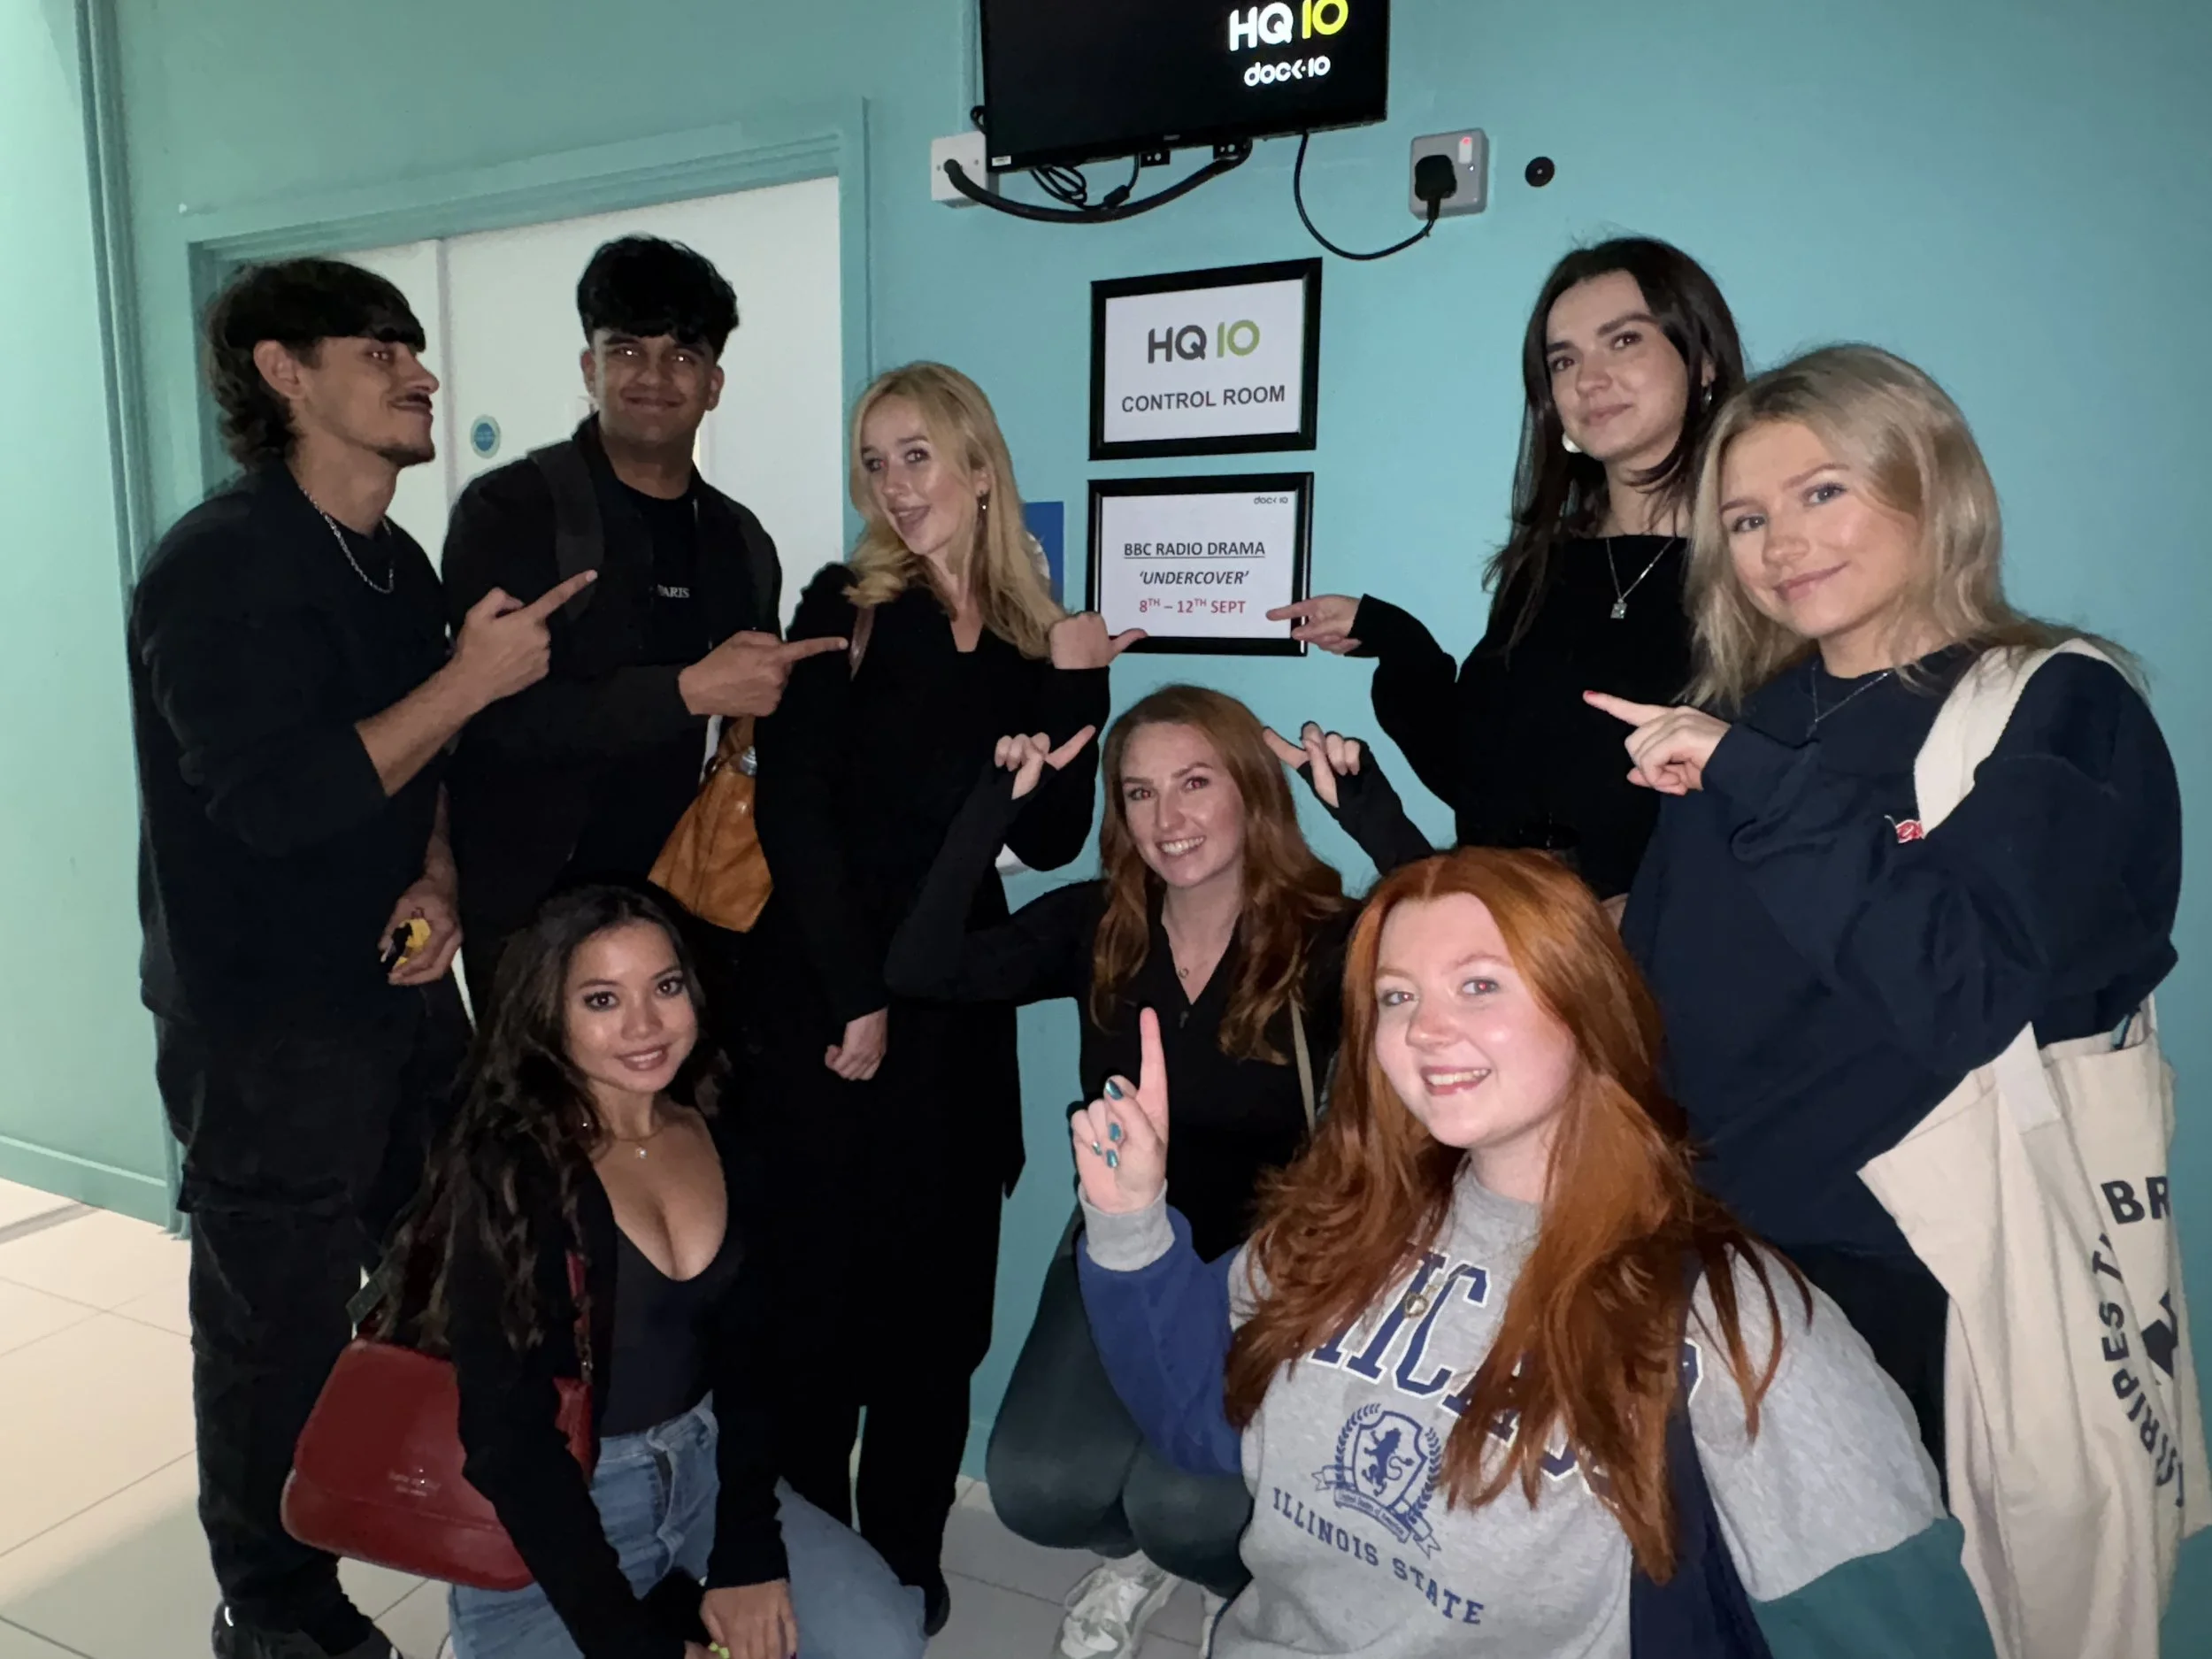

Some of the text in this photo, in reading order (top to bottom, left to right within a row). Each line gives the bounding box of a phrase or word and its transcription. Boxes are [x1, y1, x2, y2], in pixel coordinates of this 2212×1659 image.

[1229, 2, 1294, 51] HQ
[1148, 319, 1260, 364] HQ 10
[1122, 385, 1285, 412] CONTROL ROOM
[1124, 541, 1265, 557] BBC RADIO DRAMA
[1139, 598, 1161, 613] 8TH
[1177, 598, 1207, 613] 12TH
[1210, 600, 1247, 613] SEPT
[1273, 1487, 1379, 1566] ILLINOIS
[1392, 1557, 1485, 1625] STATE
